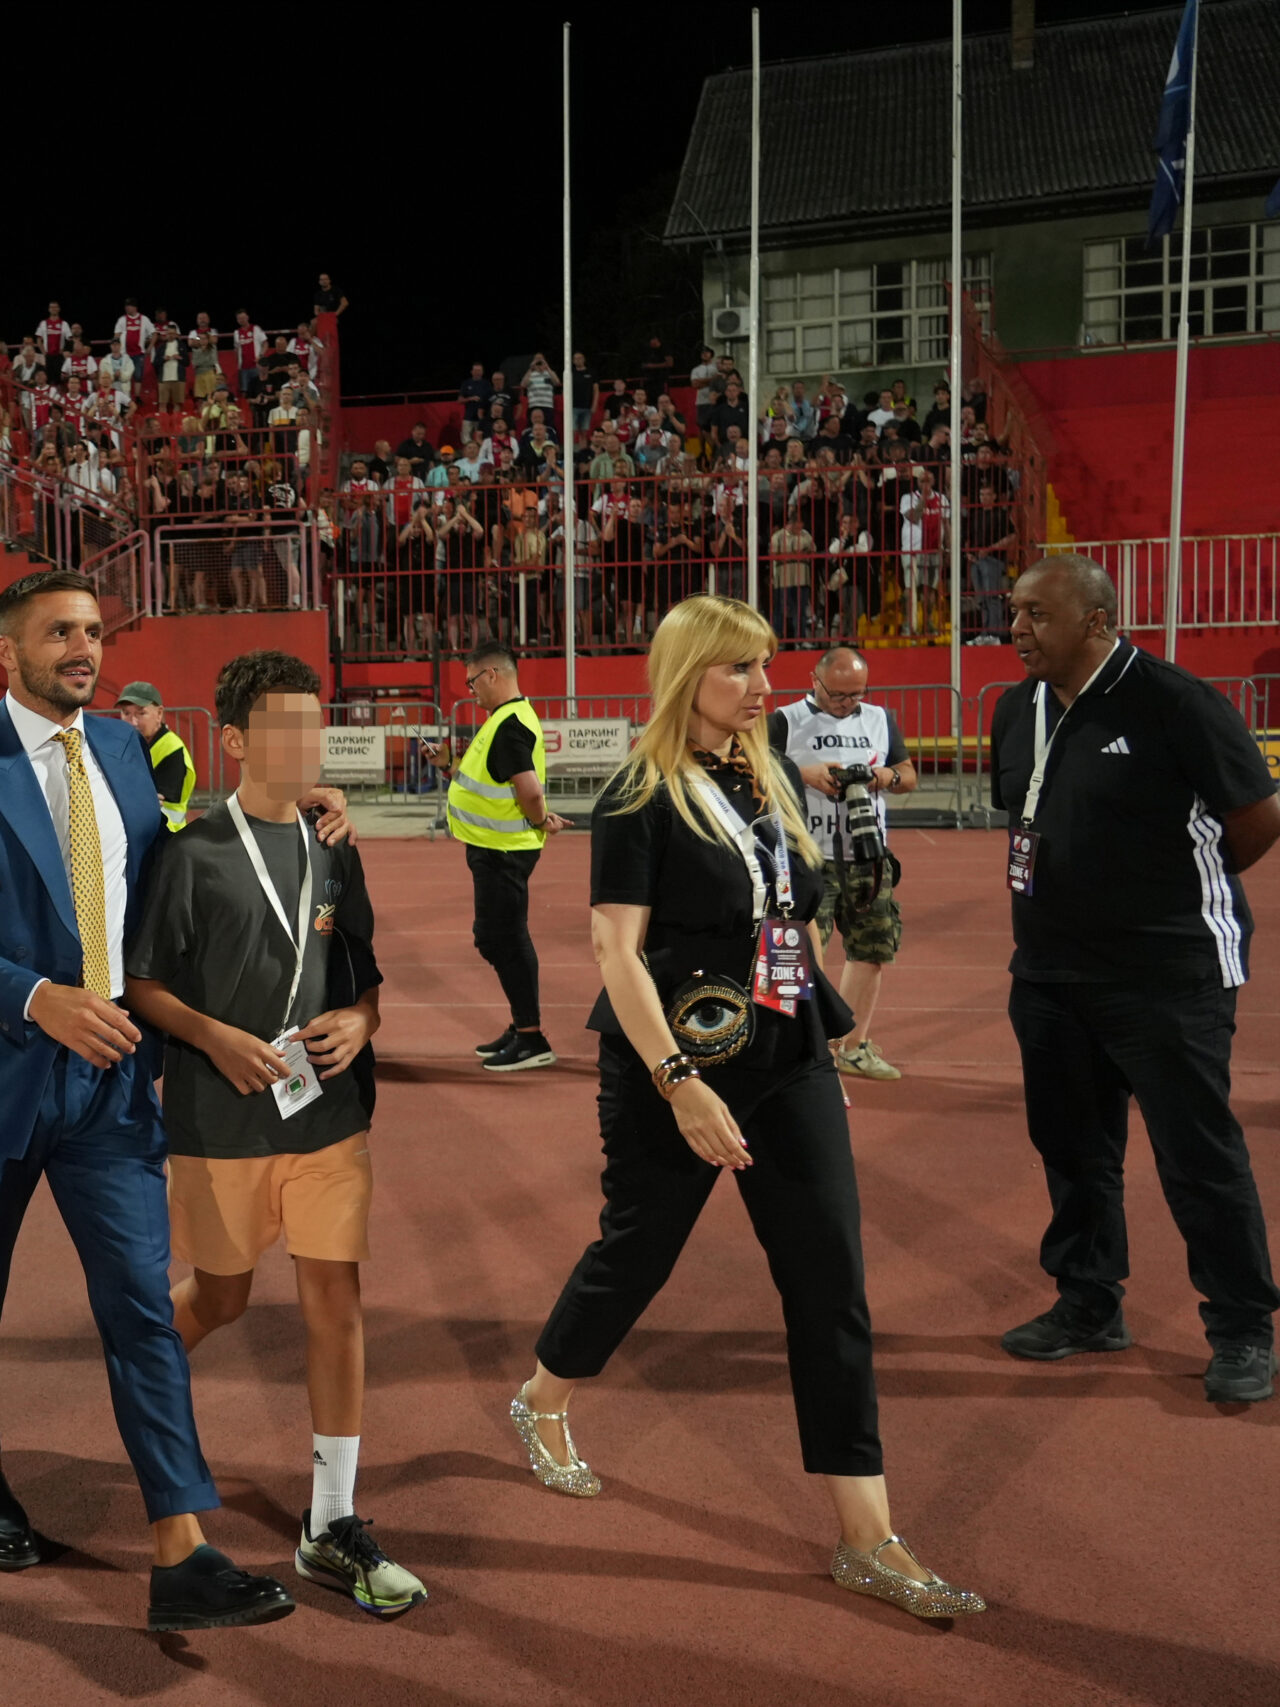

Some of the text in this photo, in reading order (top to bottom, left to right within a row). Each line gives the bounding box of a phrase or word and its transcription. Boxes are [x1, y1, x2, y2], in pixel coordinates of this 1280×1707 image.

[569, 728, 620, 738] ПАРКИНГ
[328, 736, 376, 745] ПАРКИНГ
[328, 746, 368, 755] СЕРВИС
[1010, 864, 1024, 879] ZONE
[1024, 869, 1029, 880] 4
[771, 967, 805, 980] ZONE 4
